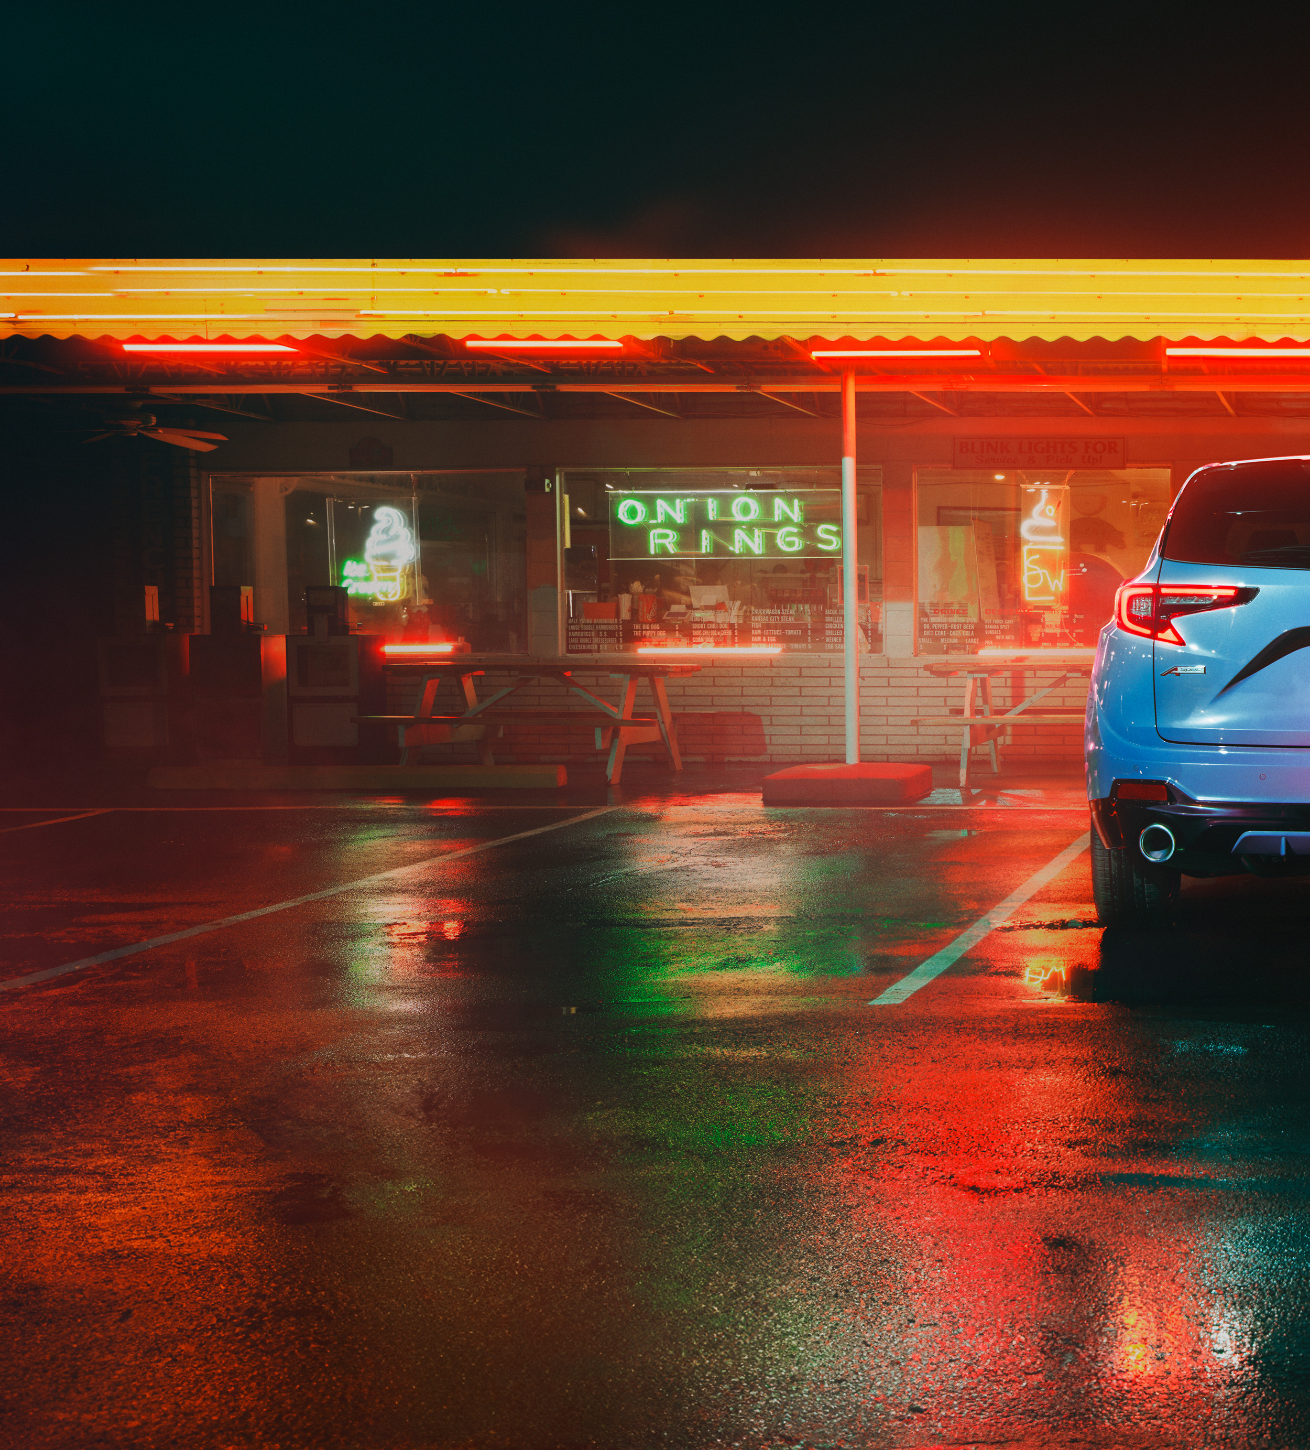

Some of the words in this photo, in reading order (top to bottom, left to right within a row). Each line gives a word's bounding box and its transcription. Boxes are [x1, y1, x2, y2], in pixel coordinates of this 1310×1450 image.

[959, 441, 1009, 454] BLINK
[1018, 441, 1078, 454] LIGHTS
[1083, 441, 1119, 454] FOR
[975, 455, 1019, 465] Service
[1027, 455, 1036, 465] &
[1046, 455, 1073, 465] Pick
[1081, 455, 1103, 466] Up!
[617, 496, 802, 524] ONION
[649, 524, 842, 555] RINGS
